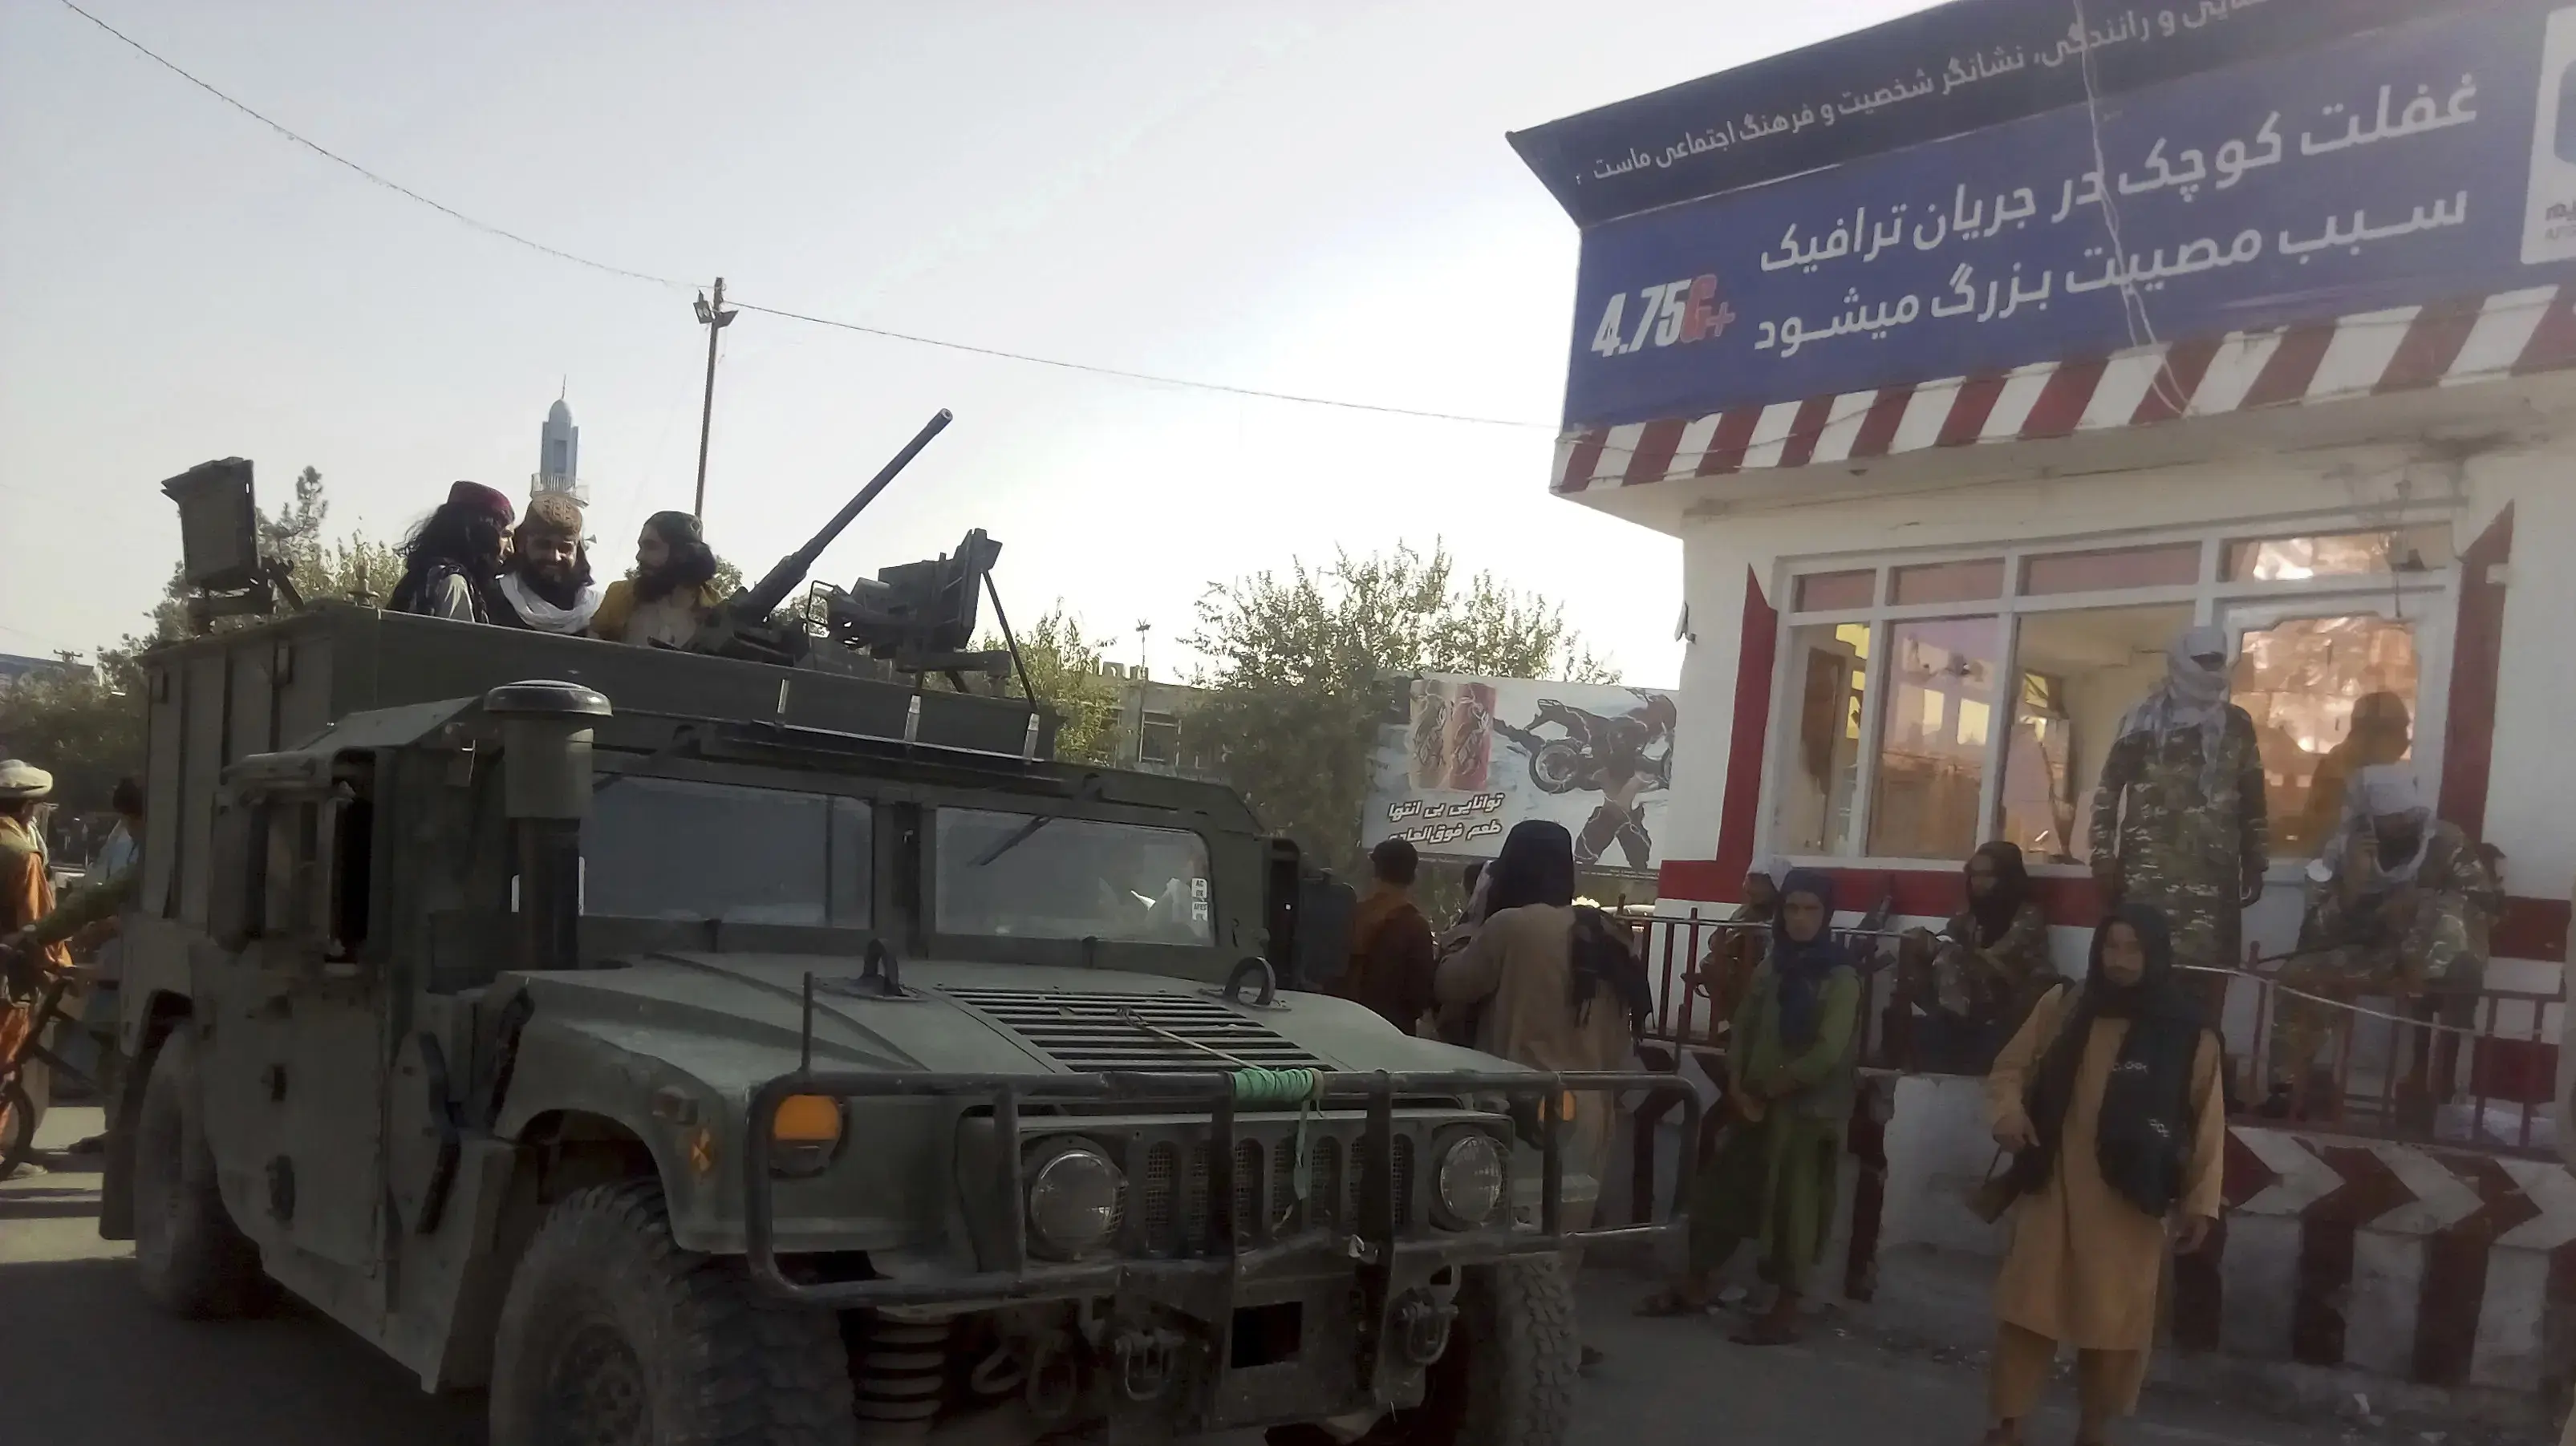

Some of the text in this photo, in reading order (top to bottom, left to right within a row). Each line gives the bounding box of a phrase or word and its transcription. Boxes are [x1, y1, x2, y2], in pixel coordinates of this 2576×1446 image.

[2157, 10, 2176, 37] و
[1837, 67, 1935, 115] شخصیت
[1941, 45, 2026, 95] نشانگر
[1739, 103, 1815, 141] فرهنگ
[1820, 103, 1836, 126] و
[1655, 120, 1737, 168] اجتماعی
[1760, 71, 2477, 274] غفلت کوچک در جریان ترافیک
[1754, 189, 2468, 358] سبب مصیبت بزرگ میشود
[1590, 273, 1736, 358] 4.75G+
[1388, 792, 1506, 822] توانایی بی انتها
[1466, 819, 1503, 841] طعم
